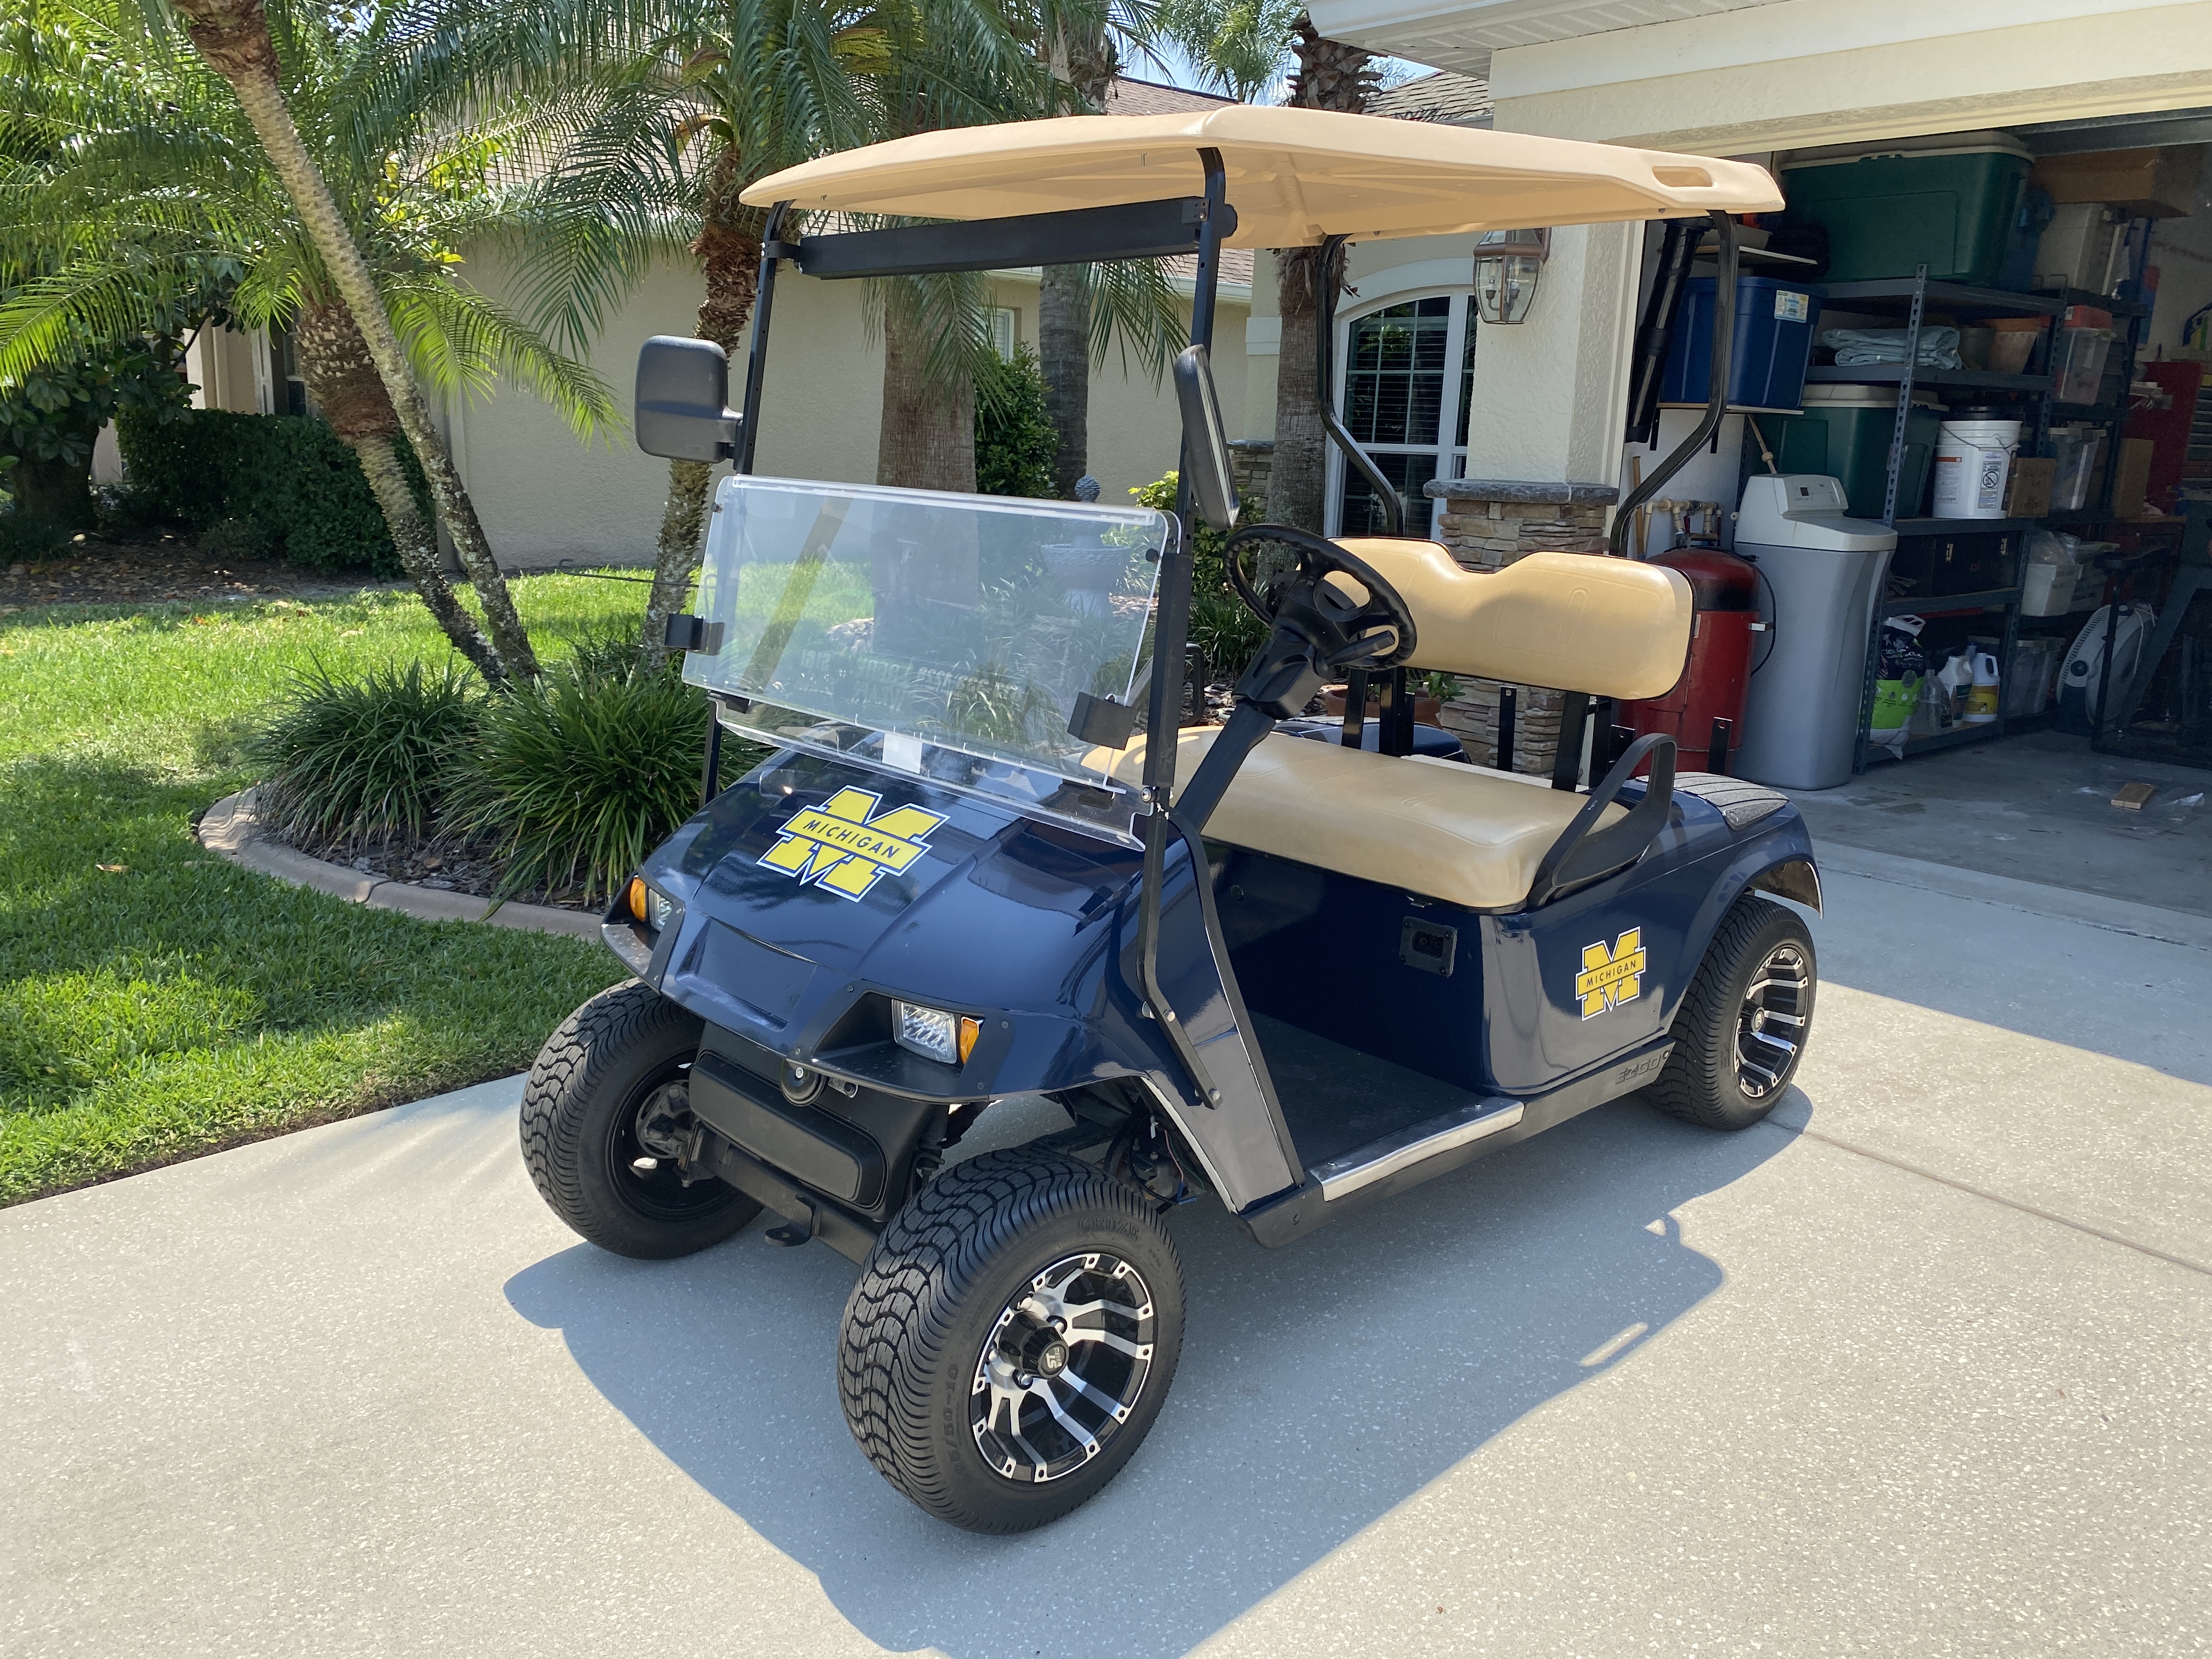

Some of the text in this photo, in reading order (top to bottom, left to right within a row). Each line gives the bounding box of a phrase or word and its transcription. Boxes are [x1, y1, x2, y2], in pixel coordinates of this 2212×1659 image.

[803, 819, 900, 859] MICHIGAN
[1587, 959, 1637, 987] MICHIGAN
[1079, 1215, 1139, 1240] CRUZE
